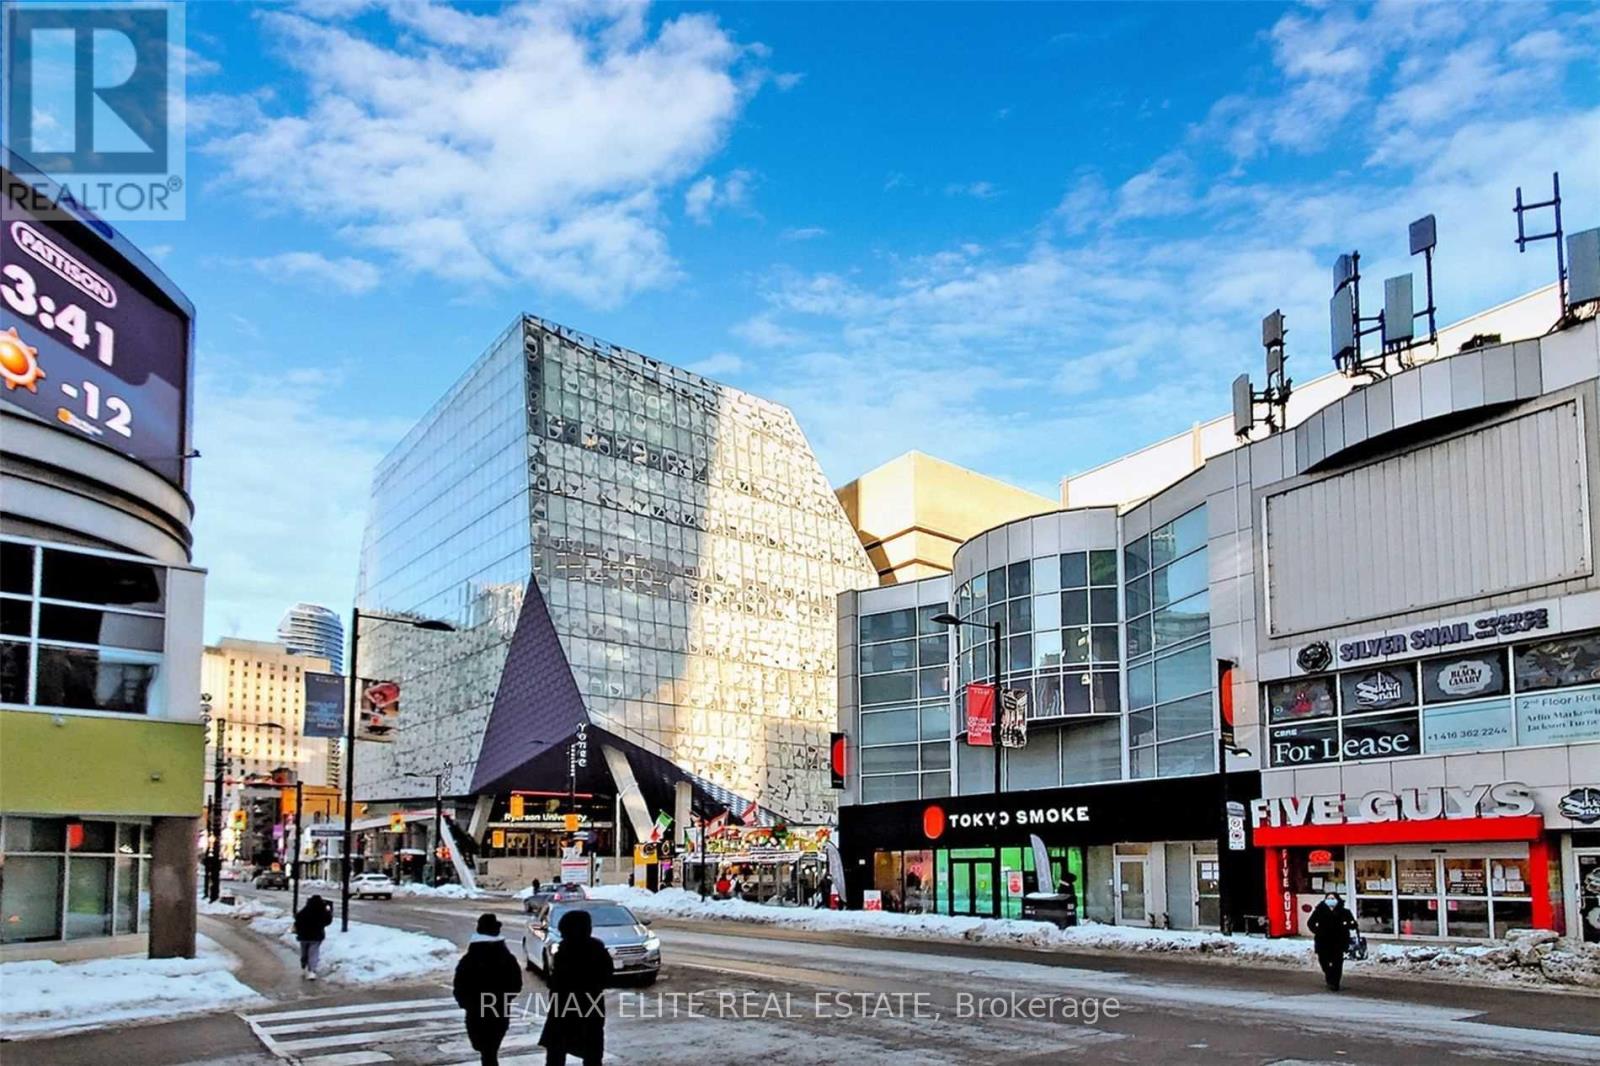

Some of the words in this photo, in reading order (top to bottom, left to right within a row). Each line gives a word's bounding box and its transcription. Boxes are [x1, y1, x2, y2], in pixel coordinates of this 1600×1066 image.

[20, 229, 110, 302] PATTISON
[0, 264, 114, 367] 3:41
[61, 381, 132, 438] -12
[1340, 633, 1407, 662] SILVER
[1410, 622, 1475, 650] SNAIL
[1450, 668, 1478, 679] BLACK
[1542, 696, 1572, 707] Floor
[1273, 742, 1316, 764] For
[1321, 733, 1411, 760] Lease
[1440, 731, 1457, 740] 416
[1460, 729, 1479, 738] 362
[1482, 727, 1508, 737] 2244
[1016, 806, 1090, 825] SMOKE
[1251, 793, 1345, 828] FIVE
[1358, 782, 1536, 823] GUYS
[1282, 848, 1290, 888] FIVE
[1283, 891, 1292, 931] GUYS
